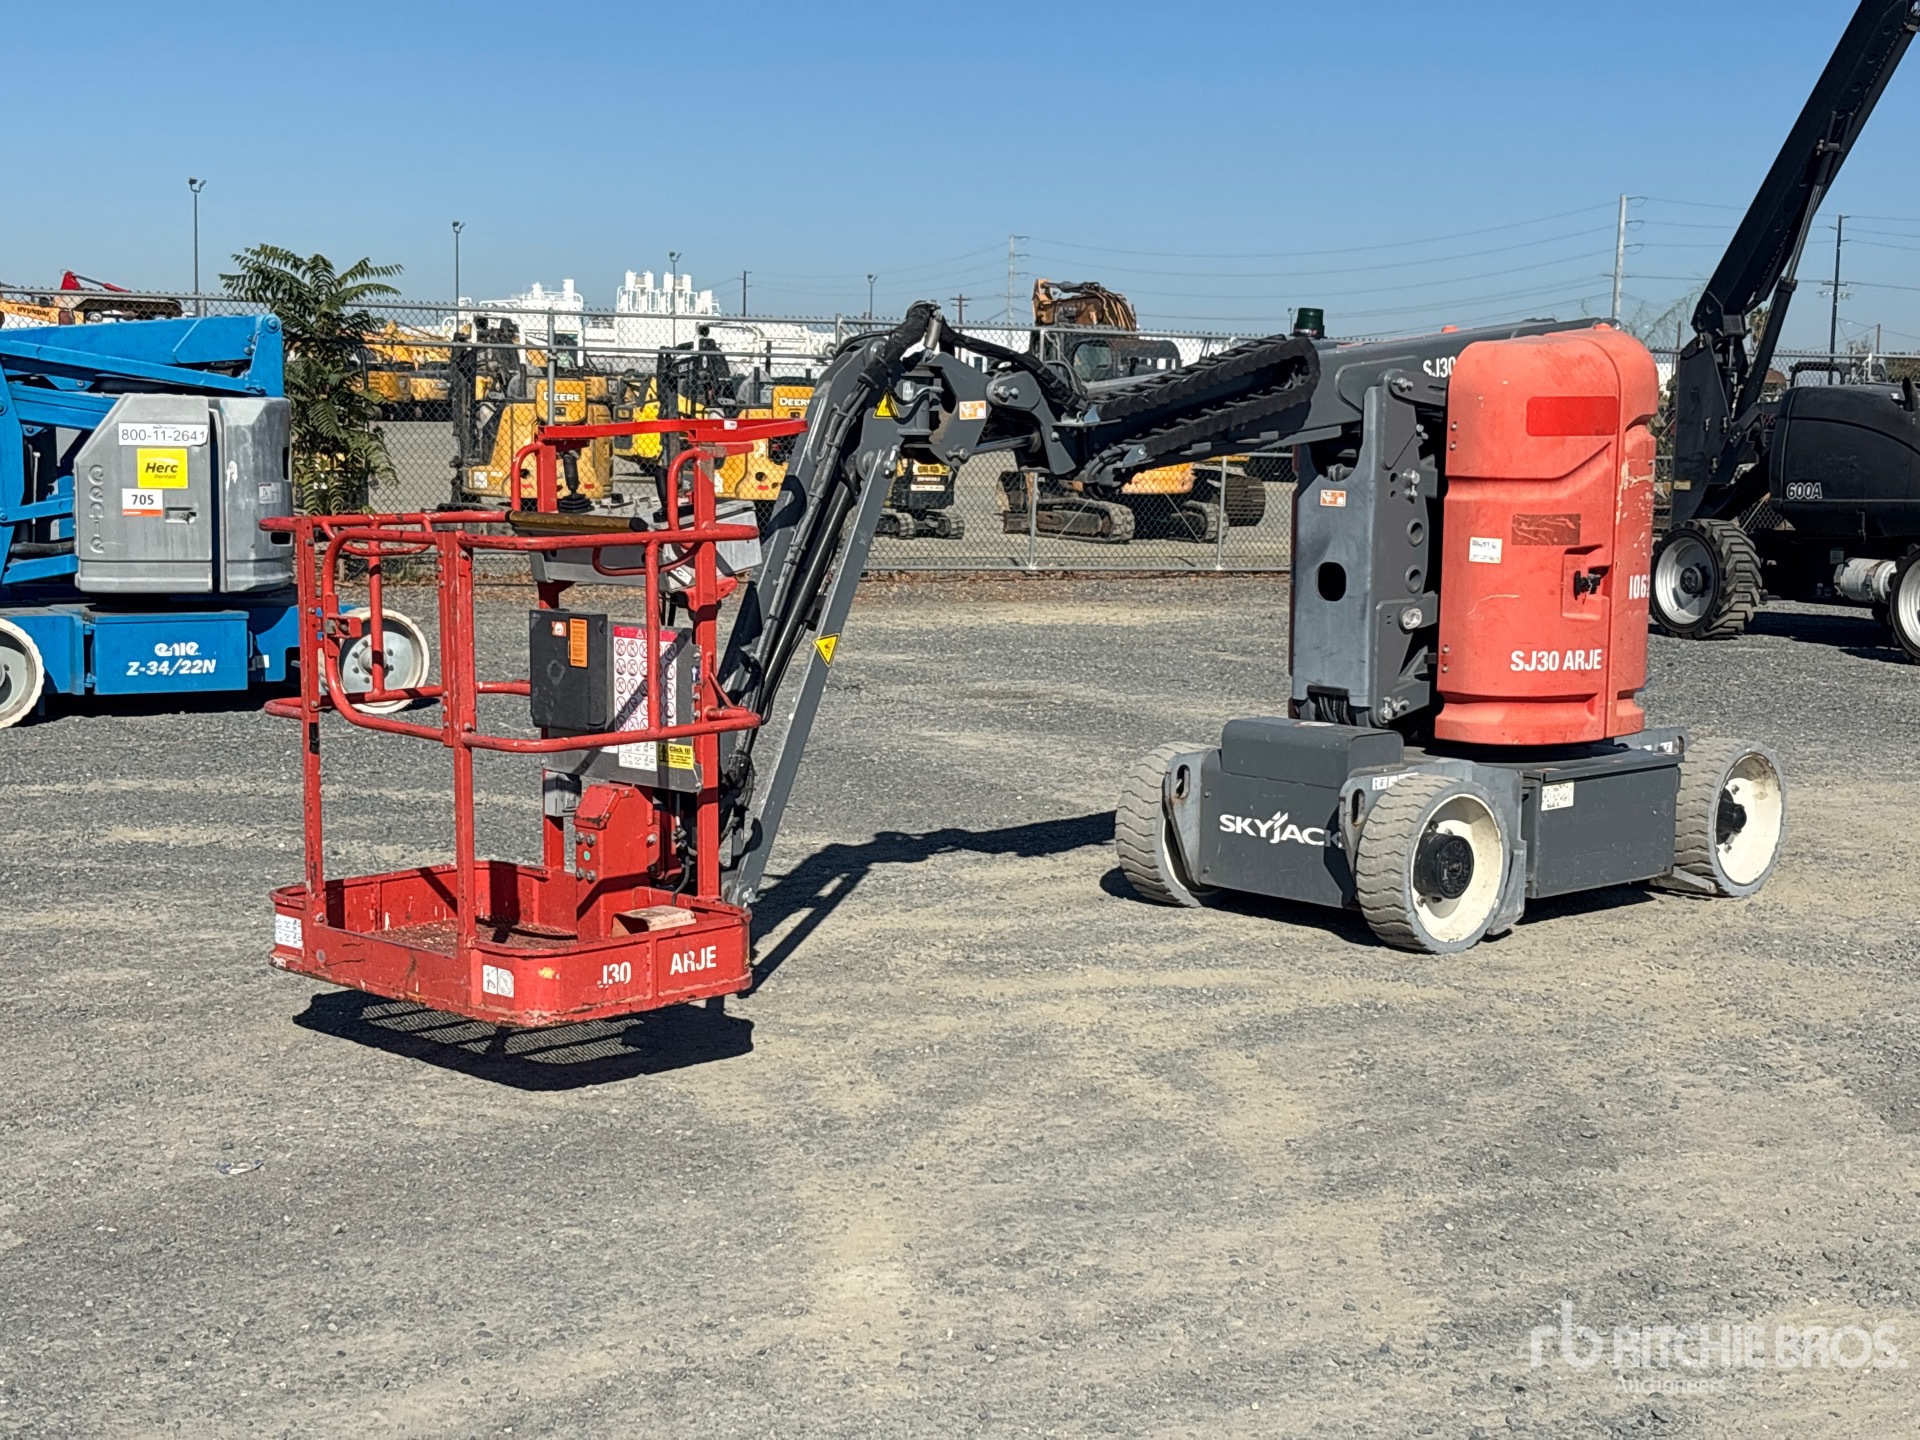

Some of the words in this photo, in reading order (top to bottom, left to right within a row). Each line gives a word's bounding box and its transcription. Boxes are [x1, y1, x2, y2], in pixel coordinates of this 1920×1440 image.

[17, 305, 50, 316] HYUNDAI
[779, 397, 811, 407] DEER
[121, 428, 205, 442] 800-11-2641
[145, 462, 179, 473] Herc
[1786, 482, 1823, 499] 600A
[131, 494, 154, 505] 705
[126, 658, 217, 676] Z-34/22N
[1510, 650, 1560, 672] SJ30
[1562, 649, 1603, 671] ARJE
[1219, 810, 1344, 850] SKYJACK
[669, 945, 717, 976] ARJE
